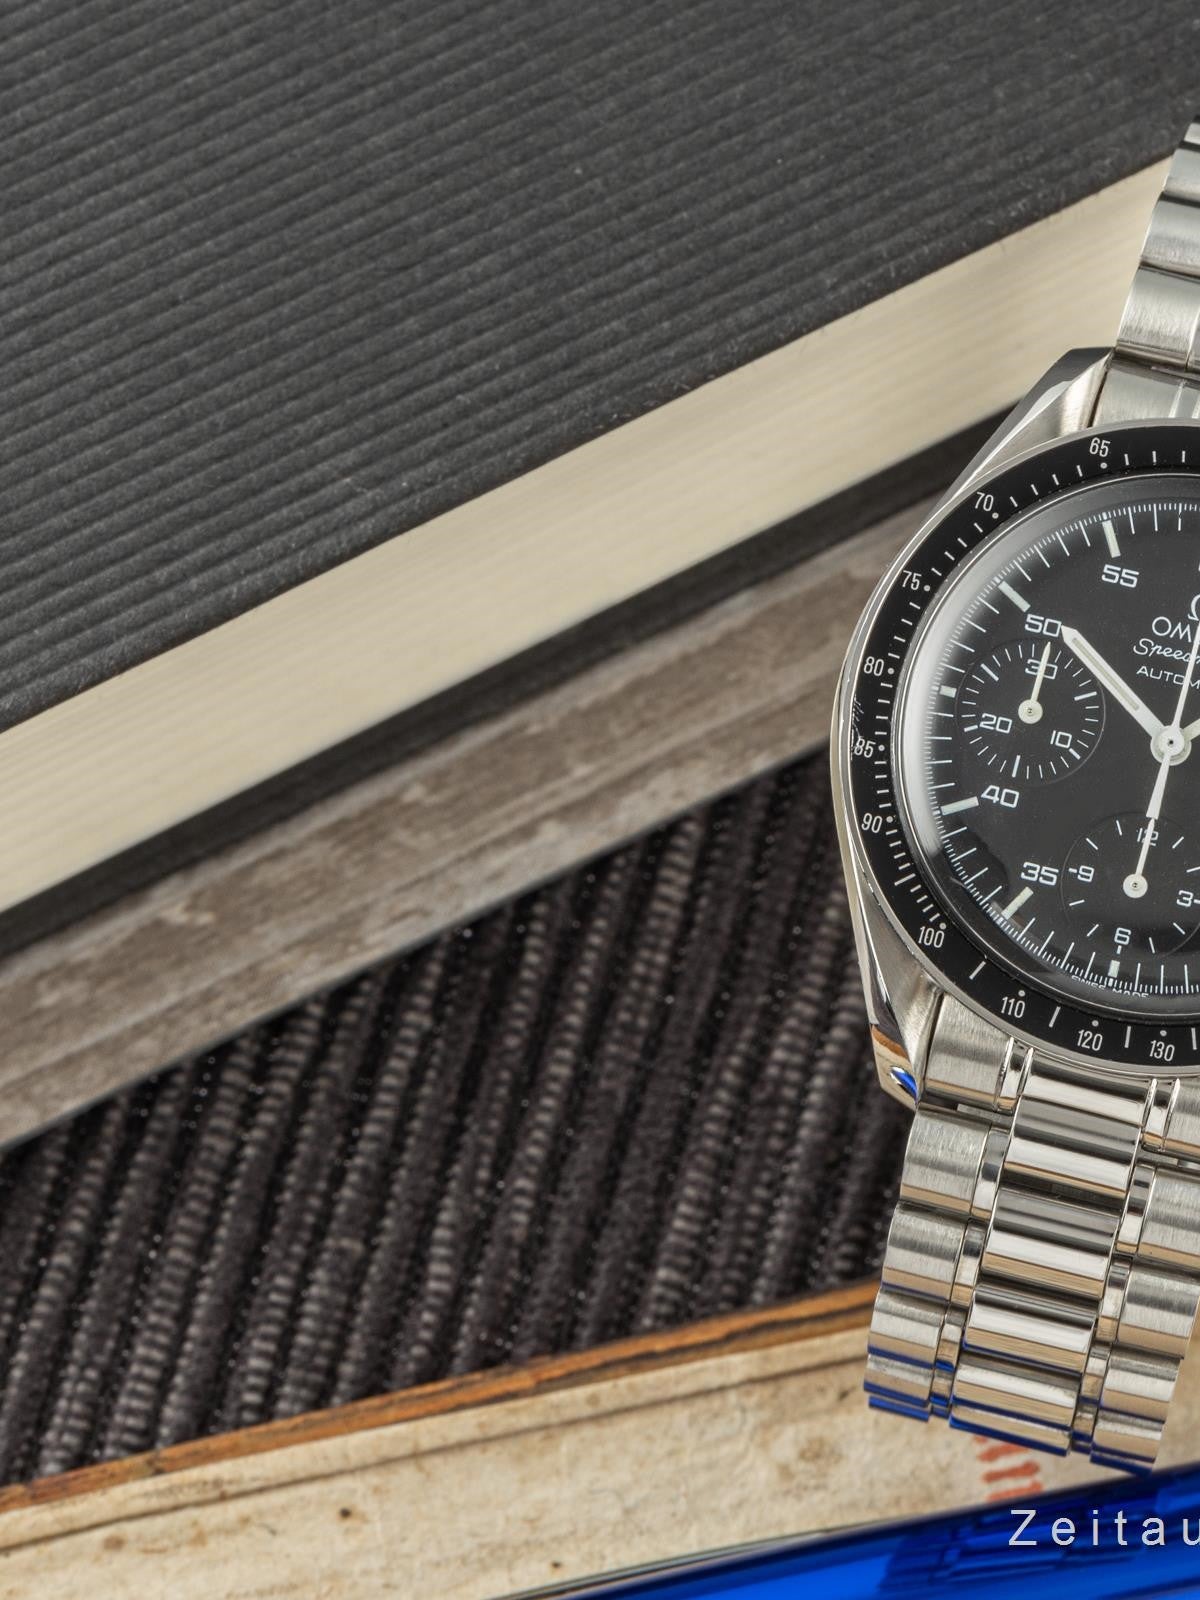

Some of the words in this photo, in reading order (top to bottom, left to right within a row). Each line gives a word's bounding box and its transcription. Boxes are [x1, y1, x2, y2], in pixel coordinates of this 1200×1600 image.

[1089, 437, 1111, 457] 65
[974, 492, 994, 512] 70
[901, 570, 922, 590] 75
[1101, 564, 1139, 588] 55
[1024, 613, 1063, 637] 50
[863, 656, 885, 676] 80
[1024, 659, 1058, 680] 30
[979, 713, 1013, 734] 20
[854, 738, 875, 758] 85
[1051, 730, 1073, 748] 10
[980, 785, 1020, 808] 40
[861, 813, 883, 834] 90
[1020, 862, 1059, 886] 35
[917, 926, 946, 949] 100
[1114, 927, 1132, 945] 6
[1001, 996, 1026, 1019] 110
[1077, 1029, 1103, 1051] 120
[1149, 1040, 1176, 1062] 130
